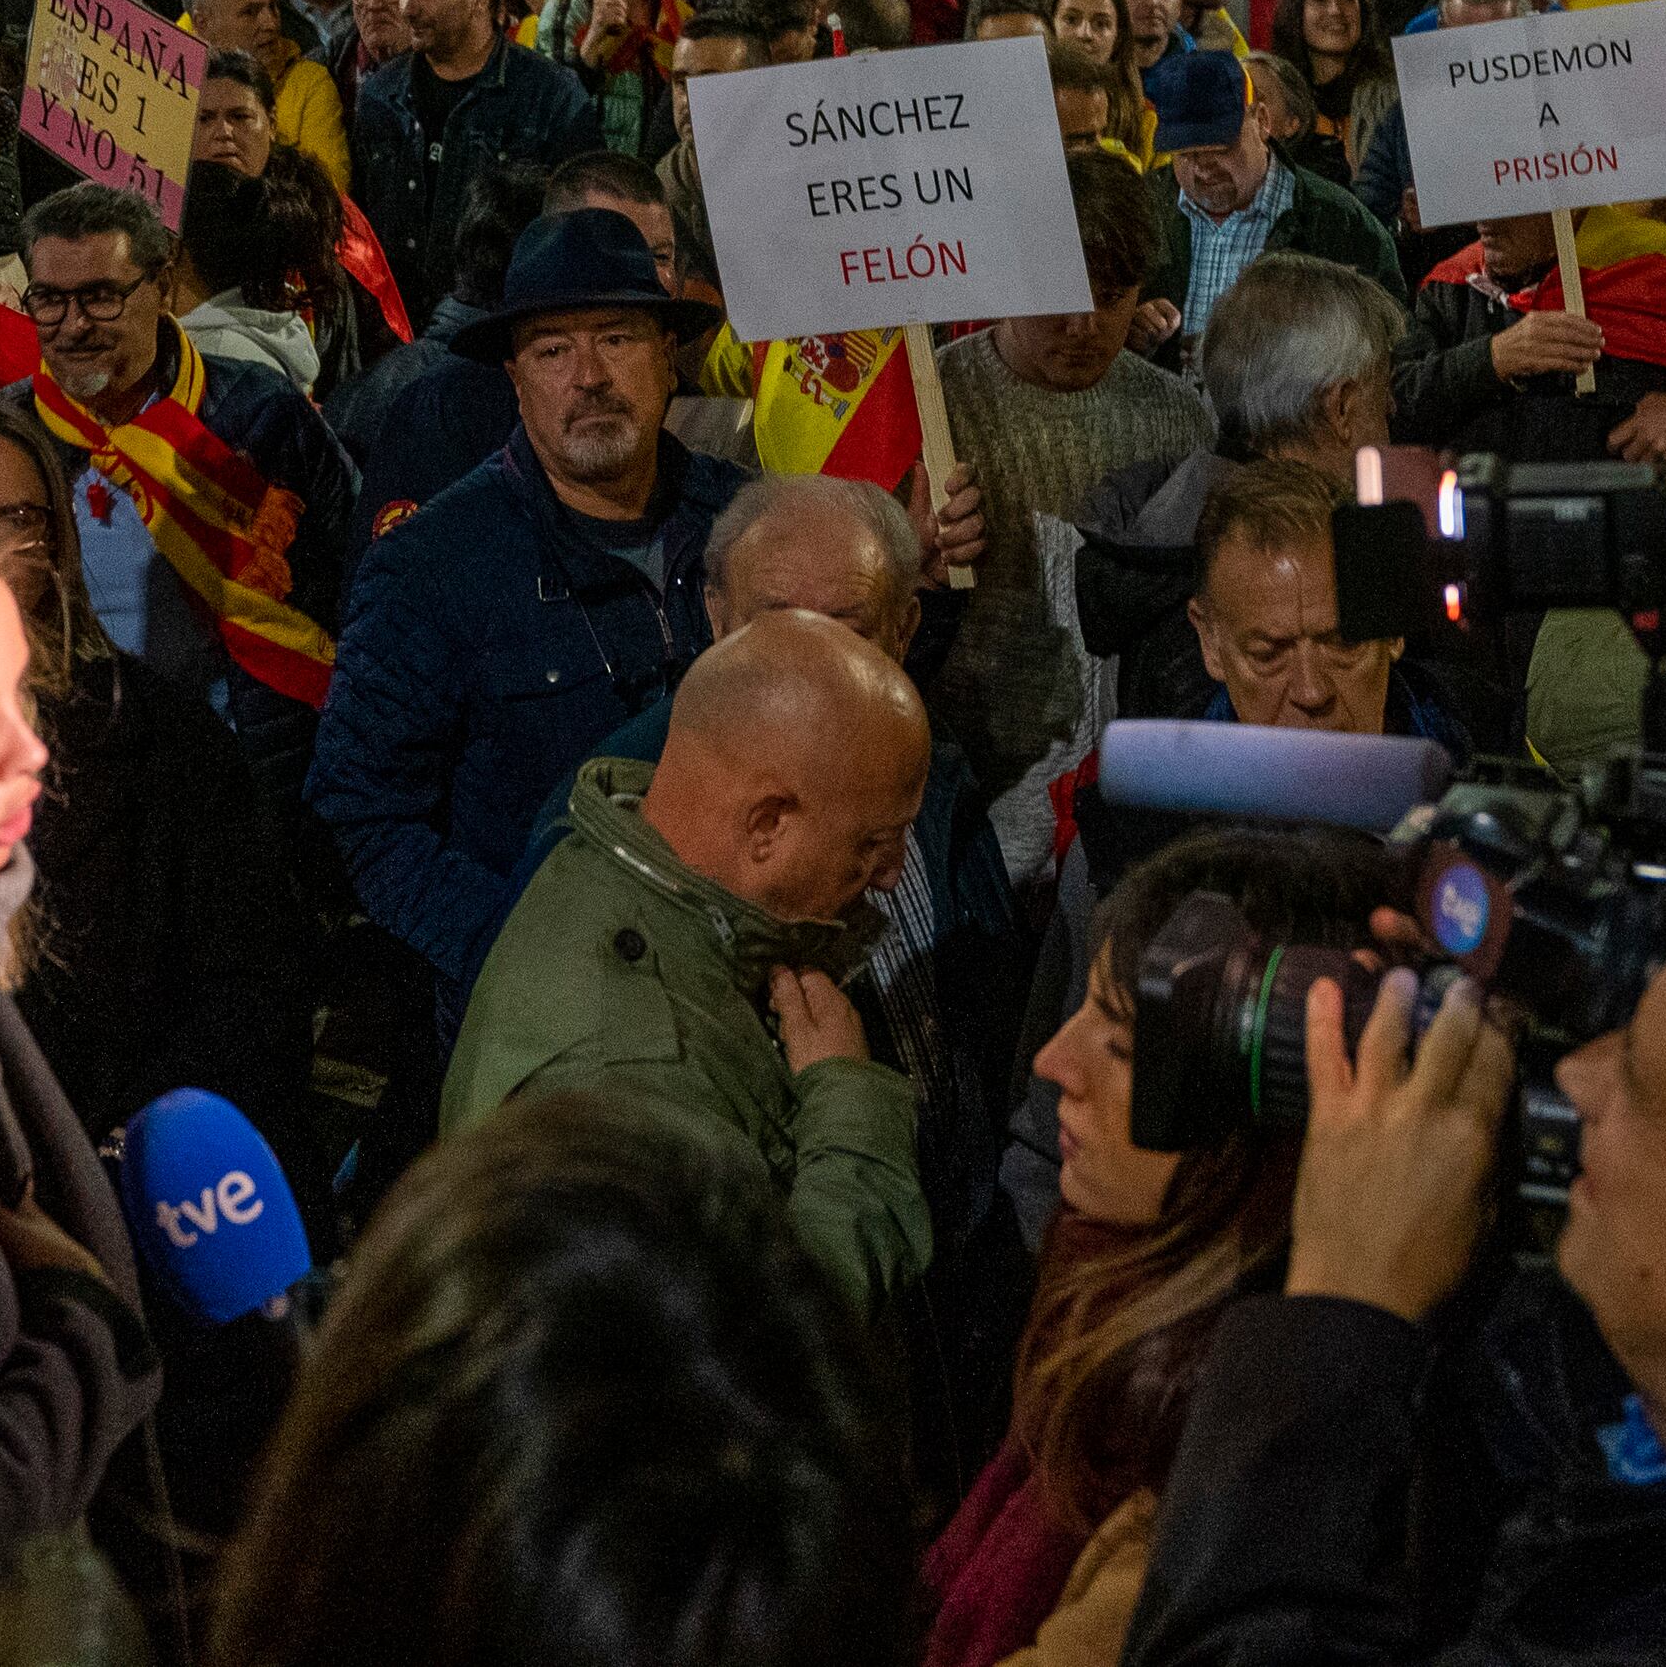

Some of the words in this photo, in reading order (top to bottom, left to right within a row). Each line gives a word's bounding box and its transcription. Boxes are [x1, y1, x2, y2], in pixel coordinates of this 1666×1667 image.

[1448, 38, 1633, 88] PUSDEMON
[77, 54, 121, 115] ES
[133, 96, 147, 136] 1
[785, 94, 970, 148] SÁNCHEZ
[1539, 101, 1561, 129] A
[38, 83, 61, 132] Y
[66, 107, 117, 171] NO
[129, 154, 165, 206] 51
[1493, 142, 1619, 186] PRISIÓN
[807, 173, 903, 218] ERES
[913, 166, 974, 205] UN
[840, 233, 968, 285] FELÓN
[155, 1170, 265, 1248] tve
